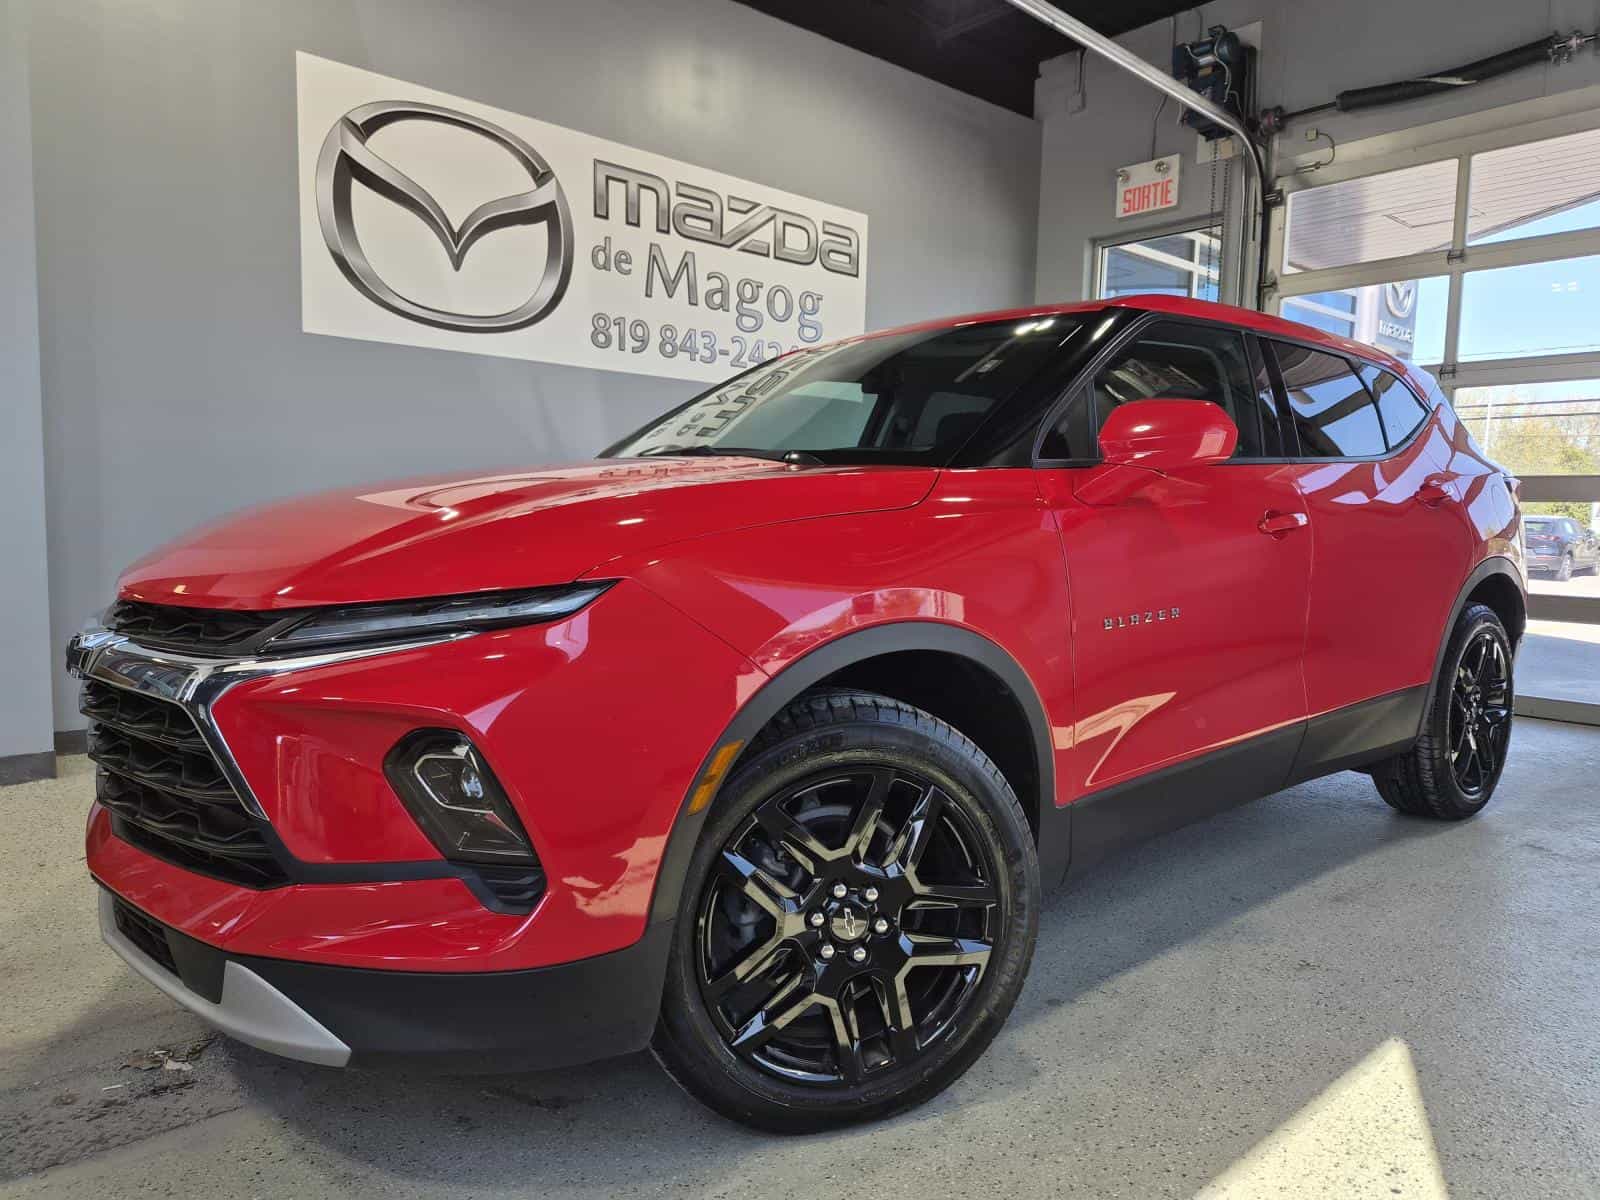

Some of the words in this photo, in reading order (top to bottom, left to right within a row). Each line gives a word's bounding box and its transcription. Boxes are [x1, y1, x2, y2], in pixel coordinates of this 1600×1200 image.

[593, 158, 859, 278] mazda
[1122, 178, 1174, 214] SORTIE
[591, 236, 633, 275] de
[644, 242, 824, 343] Magog
[590, 312, 651, 354] 819
[658, 323, 801, 369] 843-242
[1103, 607, 1181, 630] BLAZER
